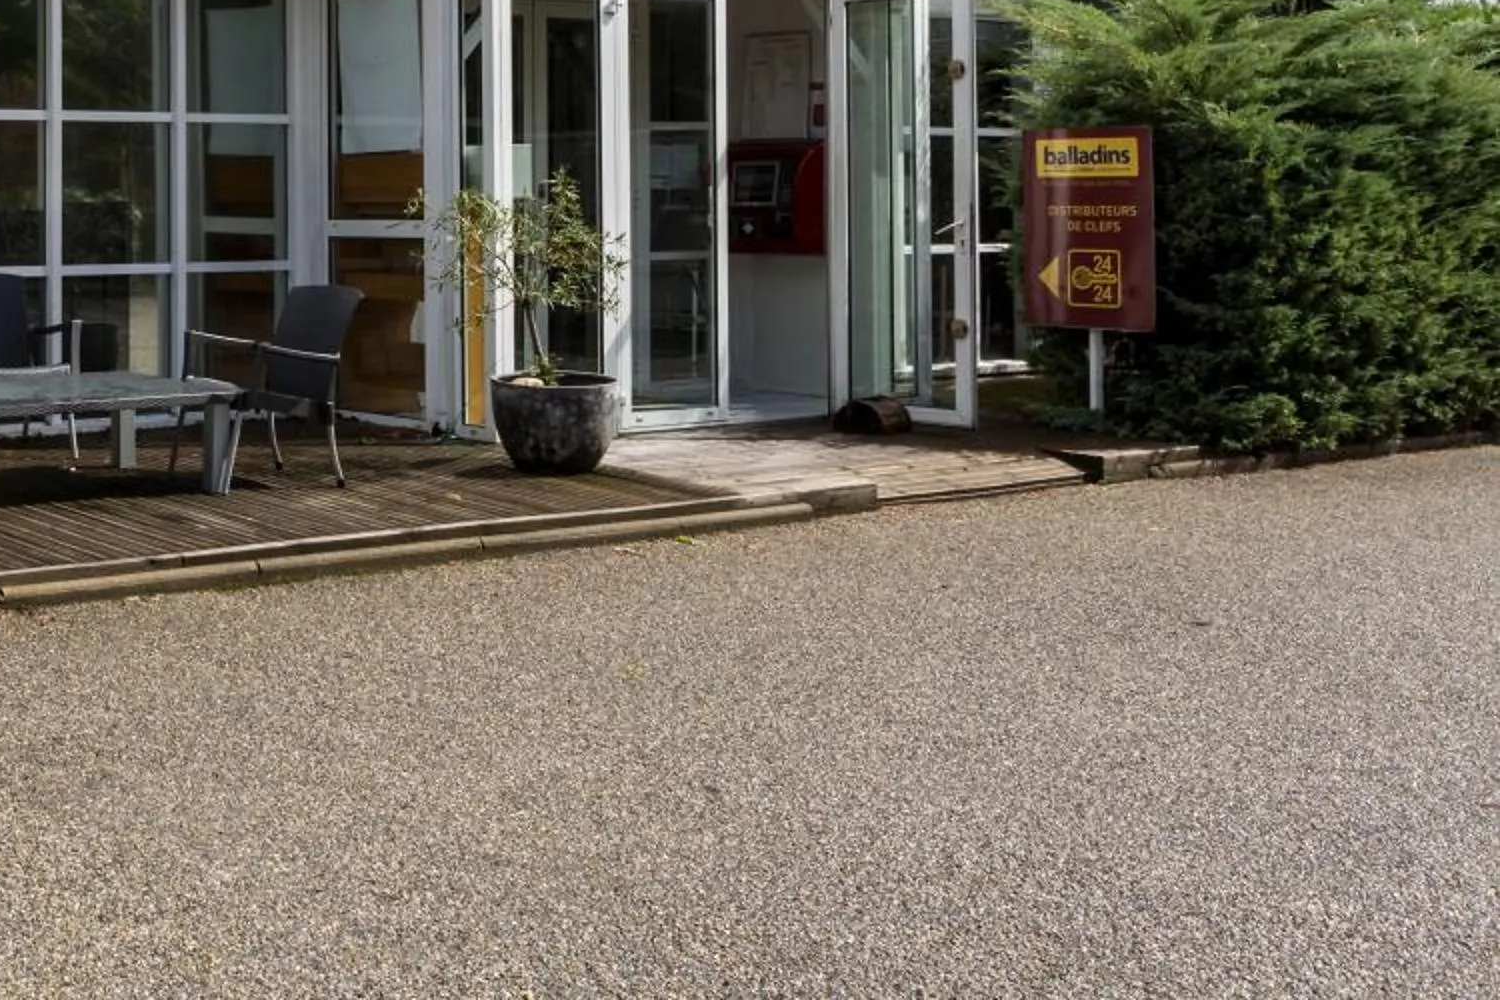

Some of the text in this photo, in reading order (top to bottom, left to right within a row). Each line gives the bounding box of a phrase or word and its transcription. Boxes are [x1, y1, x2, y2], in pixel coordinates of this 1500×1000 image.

[1044, 144, 1131, 165] balladins
[1047, 205, 1138, 217] DISTRIBUTEURS
[1067, 220, 1122, 233] DE CLEFS
[1093, 256, 1113, 274] 24
[1093, 285, 1113, 303] 24
